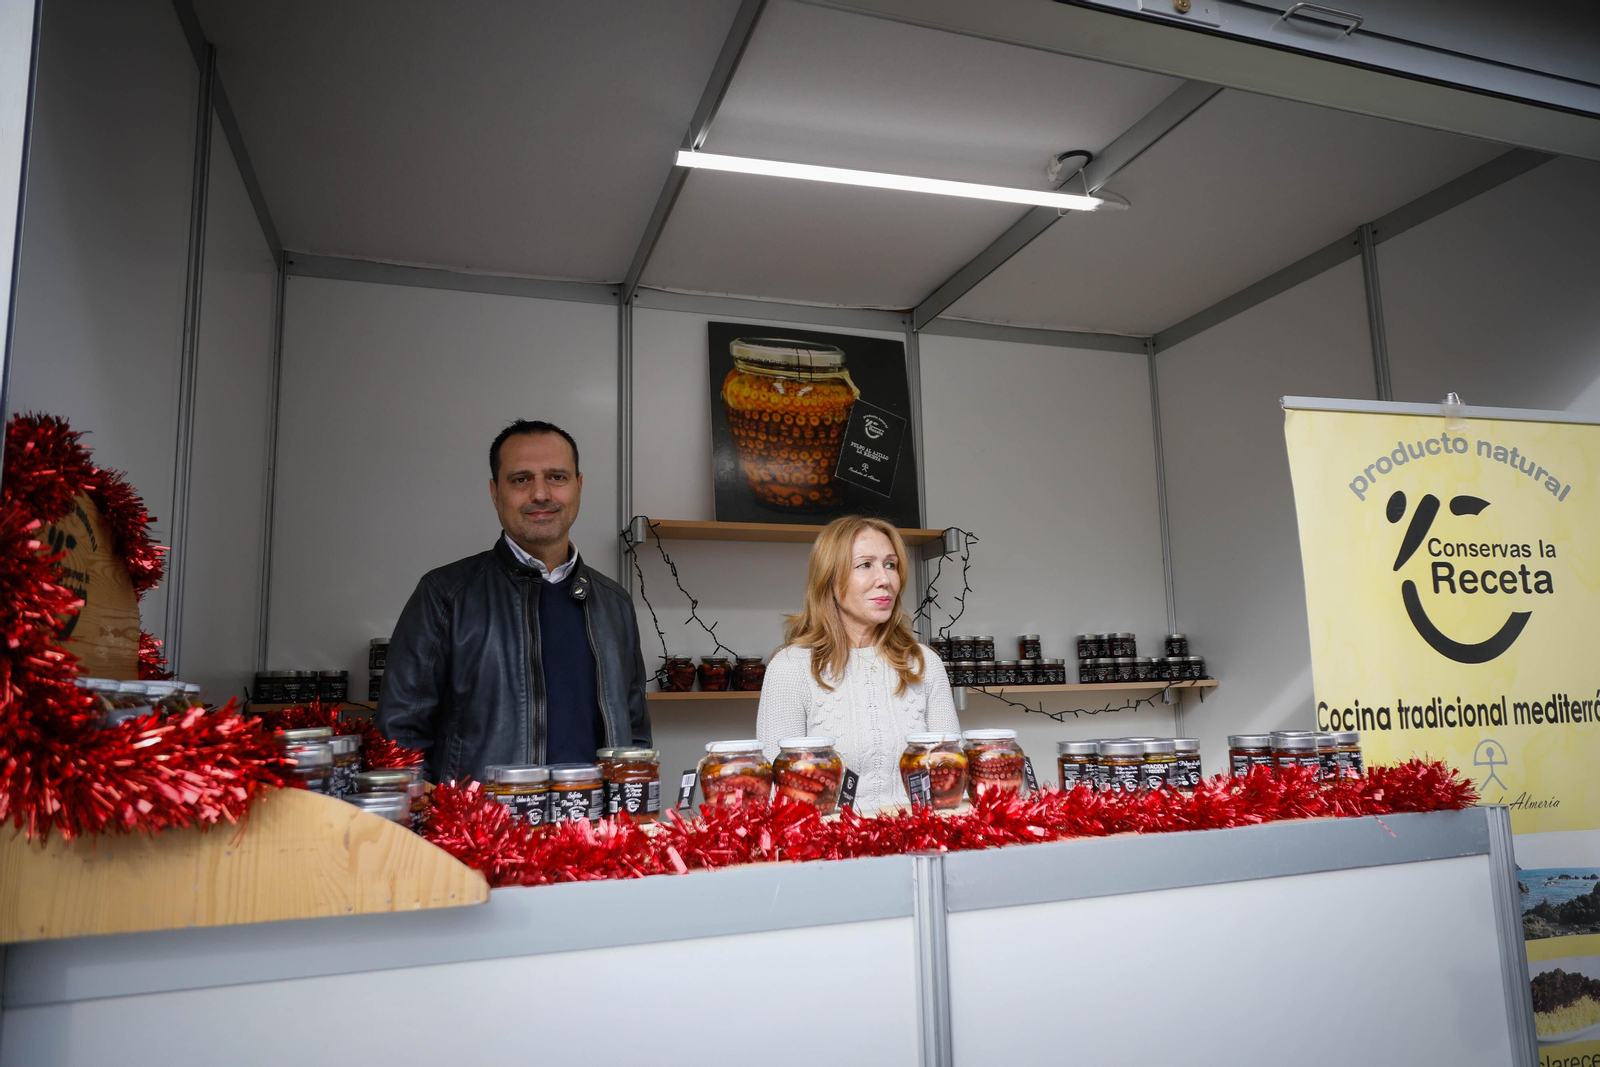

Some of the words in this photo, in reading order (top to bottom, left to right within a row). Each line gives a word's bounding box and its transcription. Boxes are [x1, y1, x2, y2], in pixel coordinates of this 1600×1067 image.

[850, 441, 866, 451] PULPO
[1349, 432, 1468, 501] producto
[1477, 440, 1571, 502] natural
[1428, 538, 1532, 557] Conservas
[1538, 539, 1556, 558] la
[1432, 561, 1554, 594] Receta
[1317, 699, 1391, 731] Cocina
[1398, 695, 1508, 729] tradicional
[1539, 1053, 1600, 1067] larece
